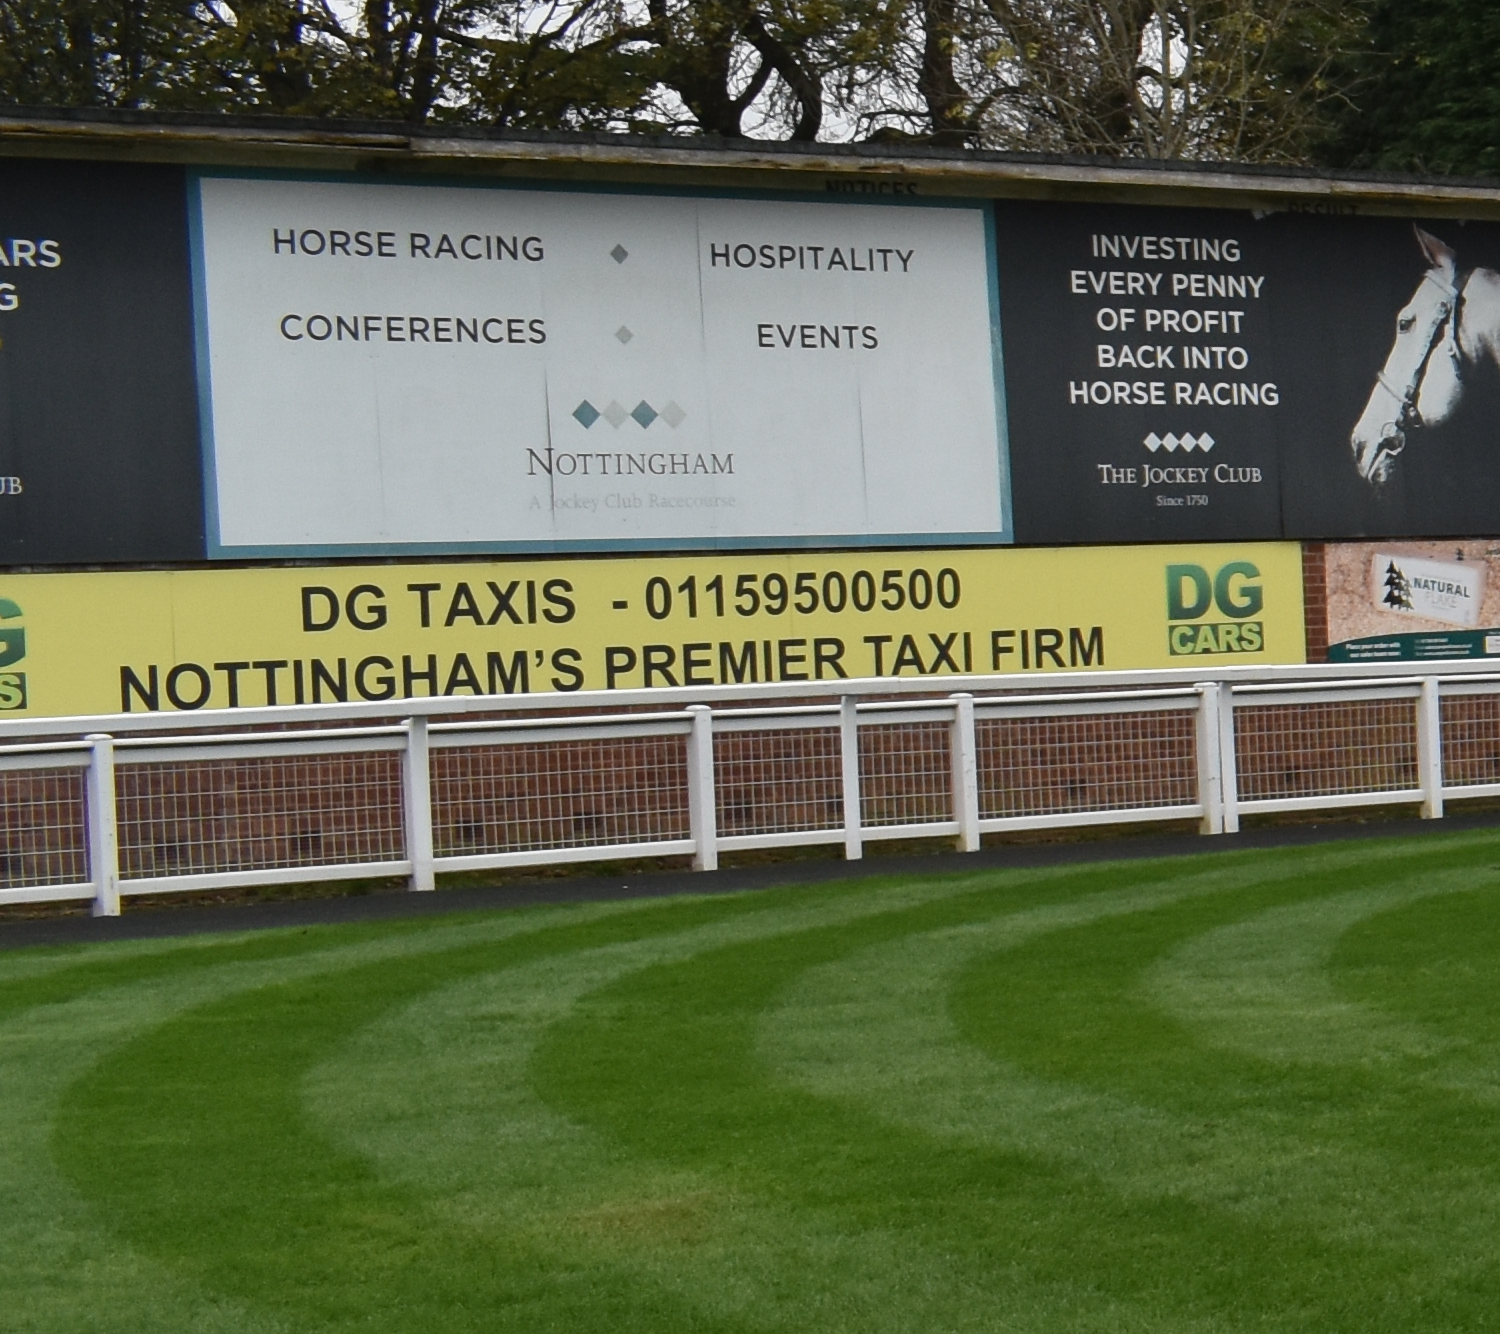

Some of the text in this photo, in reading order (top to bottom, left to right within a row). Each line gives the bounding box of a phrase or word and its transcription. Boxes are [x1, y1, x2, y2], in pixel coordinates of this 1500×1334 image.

[0, 239, 62, 268] RS
[273, 228, 545, 262] HORSE RACING
[710, 243, 914, 273] HOSPITALITY
[1091, 234, 1241, 263] INVESTING
[1070, 270, 1265, 299] EVERY PENNY
[280, 314, 547, 345] CONFERENCES
[1096, 307, 1245, 334] OF PROFIT
[757, 323, 878, 350] EVENTS
[1097, 344, 1249, 370] BACK INTO
[1069, 380, 1280, 407] HORSE RACING
[526, 447, 736, 476] NOTTINGHAM
[605, 493, 642, 509] Club
[650, 493, 736, 509] Racecourse
[1156, 494, 1209, 506] Since 1750
[300, 584, 388, 632] DG
[407, 578, 577, 629] TAXIS
[645, 567, 961, 620] 01159500500
[1166, 561, 1264, 621] DG
[1413, 576, 1471, 598] NATURAL
[1171, 623, 1262, 655] CARS
[119, 626, 1105, 713] NOTTINGHAM'S PREMIER TAXI FIRM
